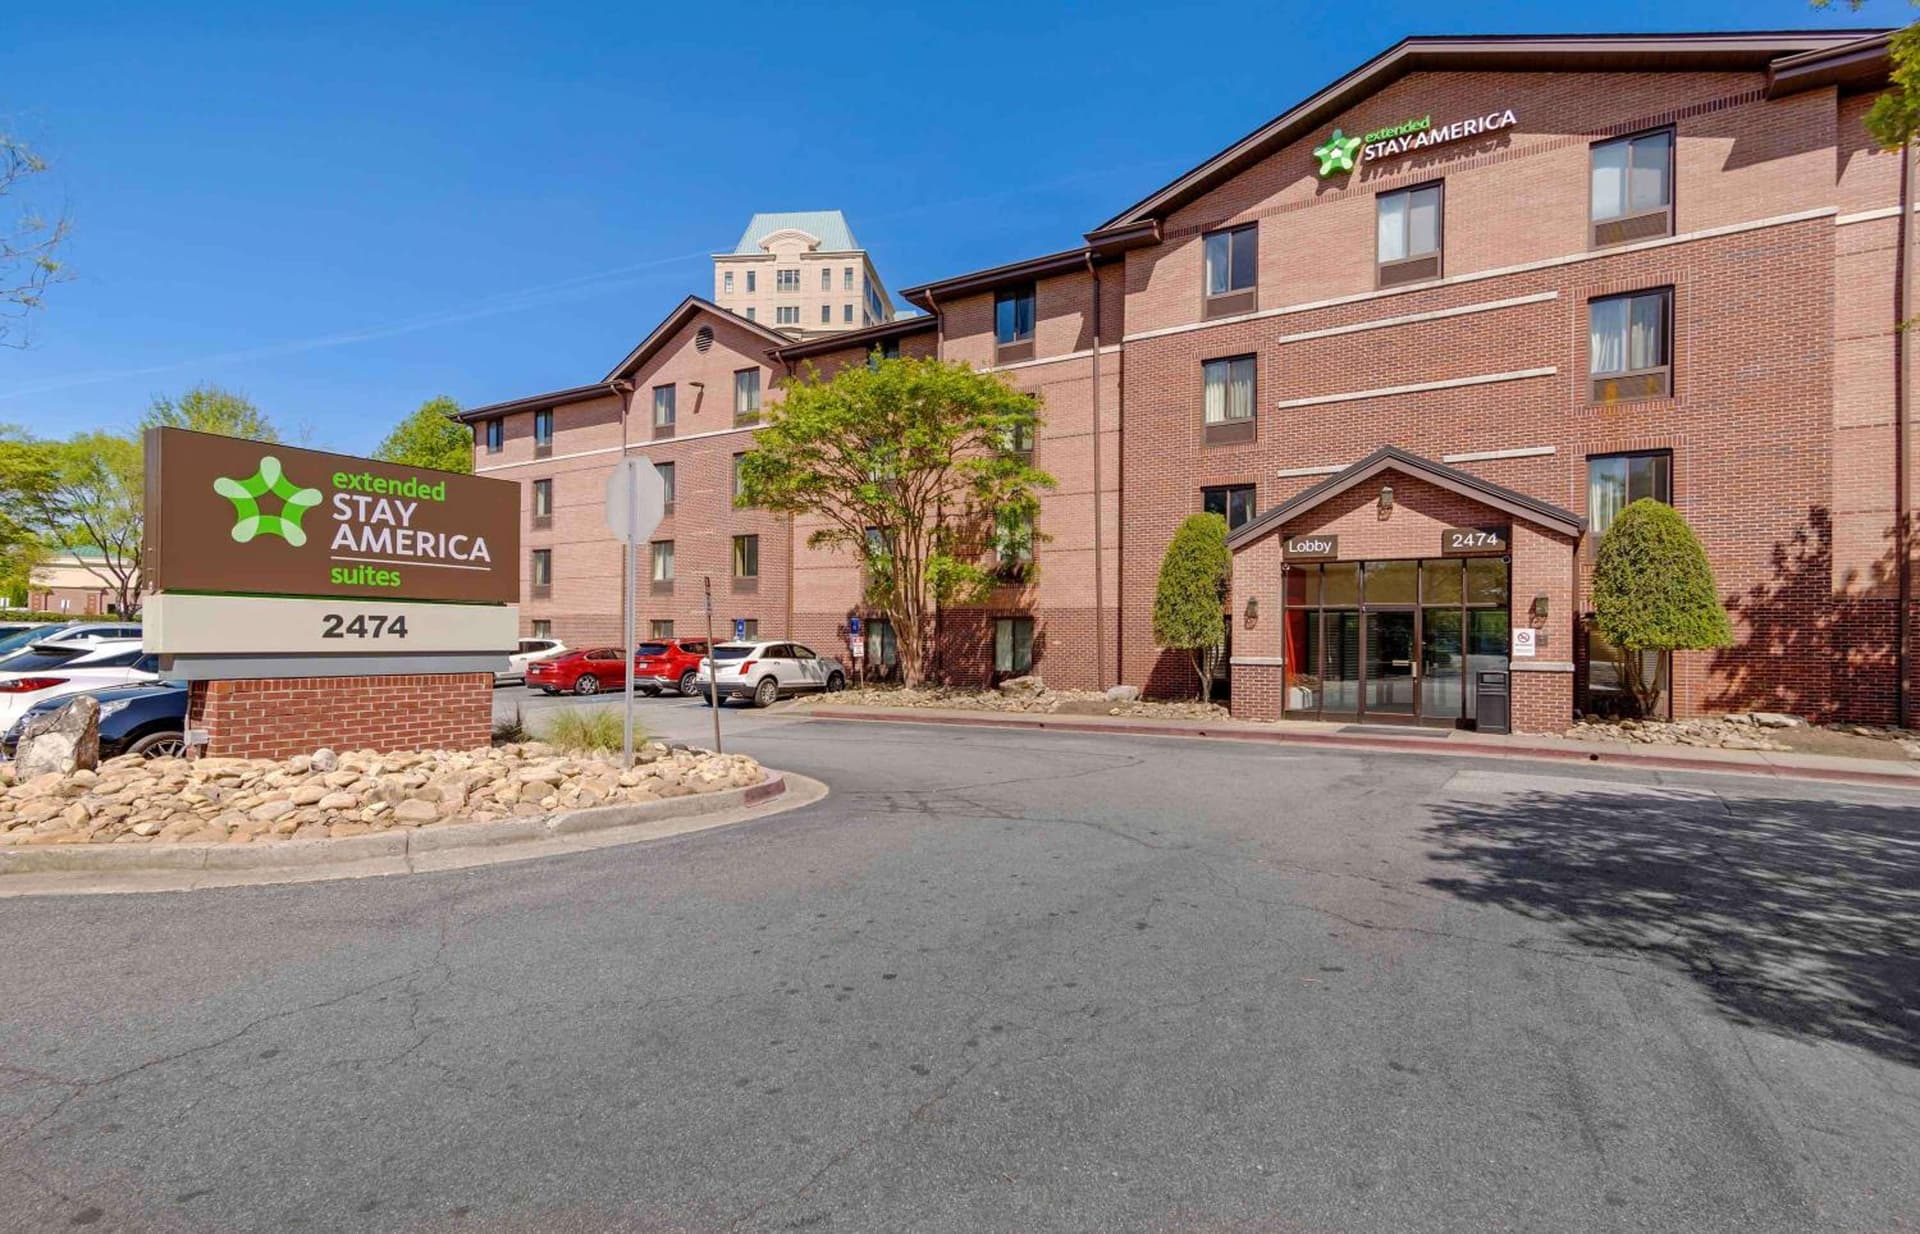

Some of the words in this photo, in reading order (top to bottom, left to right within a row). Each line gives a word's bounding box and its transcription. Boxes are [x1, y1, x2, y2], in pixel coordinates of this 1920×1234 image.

[1364, 133, 1414, 161] STAY
[1414, 109, 1518, 149] AMERICA
[1365, 115, 1431, 142] extended
[332, 472, 446, 502] extended
[332, 493, 418, 527] STAY
[330, 523, 492, 562] AMERICA
[1289, 540, 1333, 554] Lobby
[1452, 532, 1498, 548] 2474
[331, 565, 401, 588] suites
[322, 614, 408, 638] 2474
